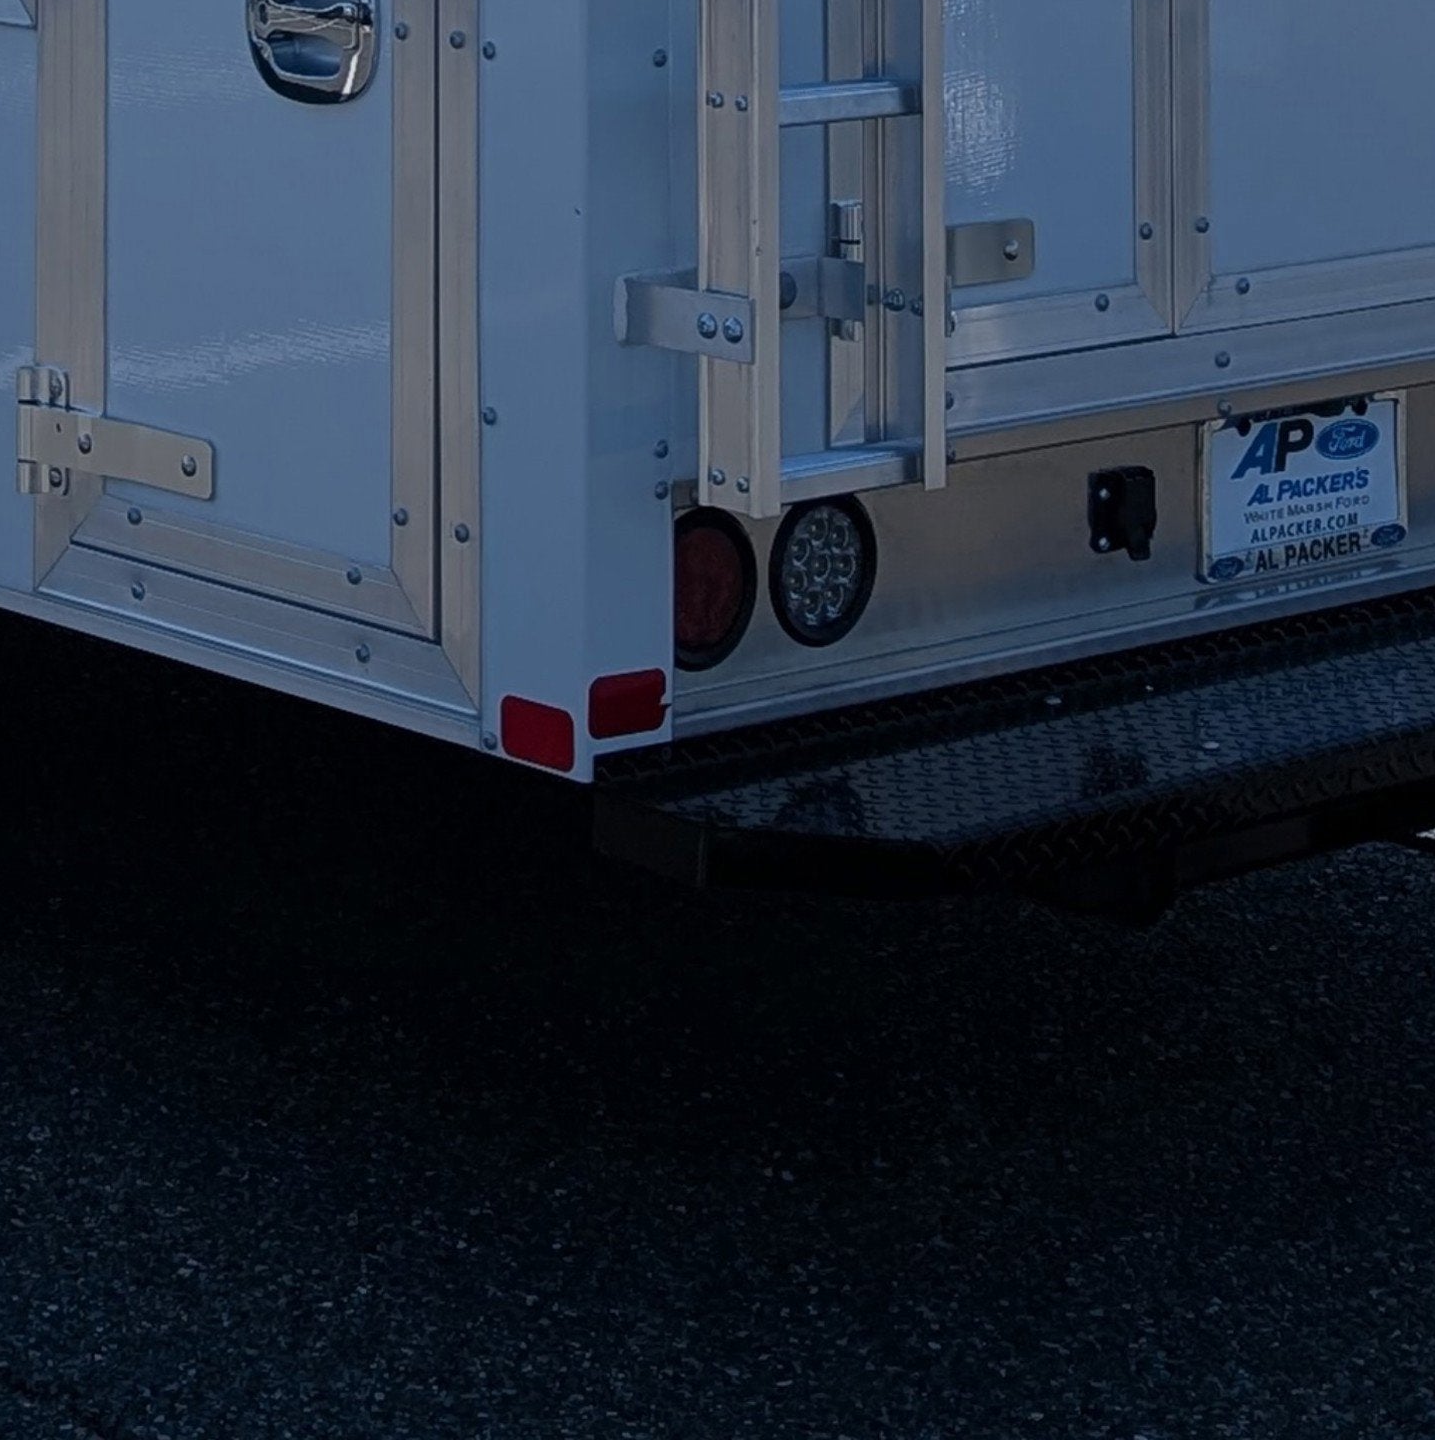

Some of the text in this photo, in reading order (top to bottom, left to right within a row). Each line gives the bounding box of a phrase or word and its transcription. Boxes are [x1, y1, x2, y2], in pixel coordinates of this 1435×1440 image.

[1231, 419, 1315, 480] AP
[1247, 466, 1370, 507] AL PACKER'S
[1250, 512, 1359, 543] ALPACKER.COM
[1255, 548, 1280, 573] AL
[1283, 531, 1362, 567] PACKER
